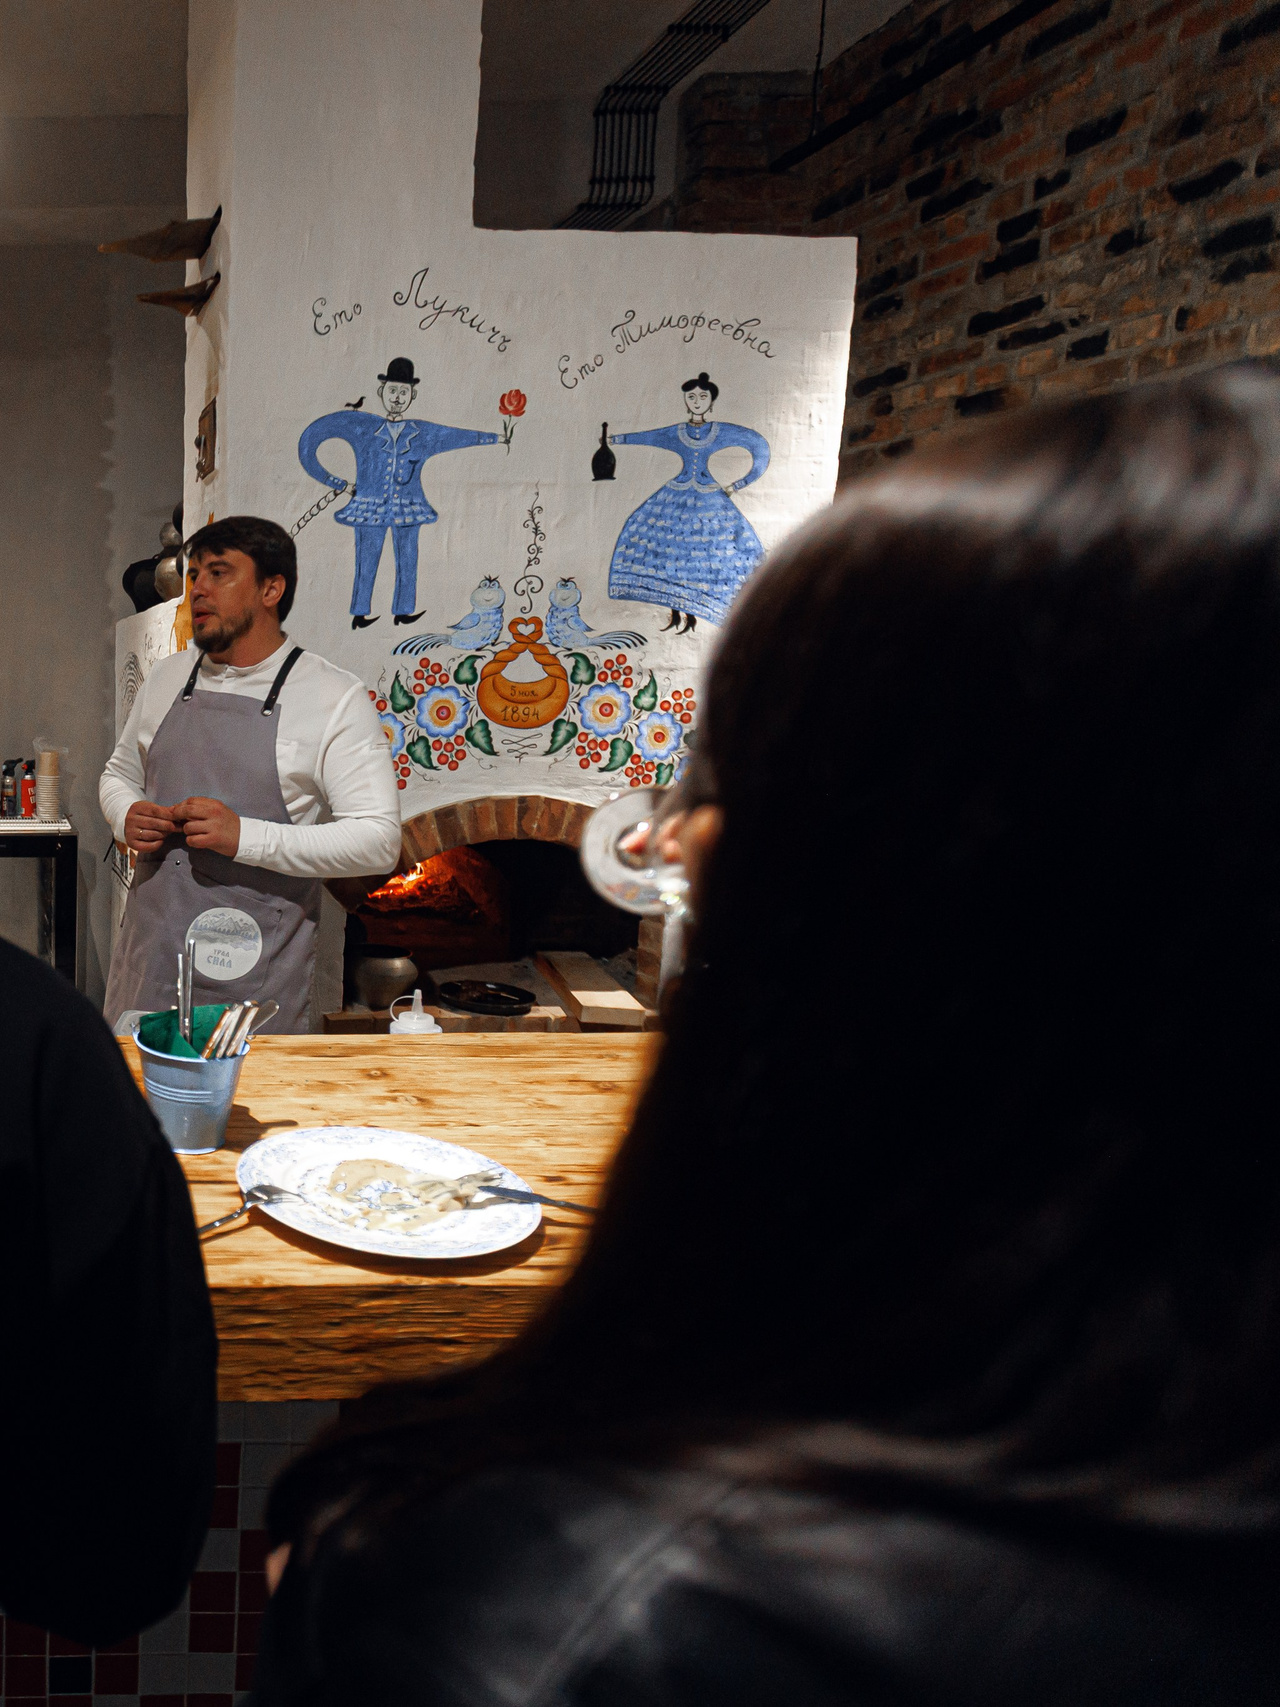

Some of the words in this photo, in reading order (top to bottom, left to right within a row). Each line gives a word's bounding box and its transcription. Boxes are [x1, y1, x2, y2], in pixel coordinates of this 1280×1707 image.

[392, 266, 512, 353] Лукичъ
[610, 308, 777, 359] Тимофеевна
[510, 685, 517, 697] 5
[501, 705, 540, 723] 1894
